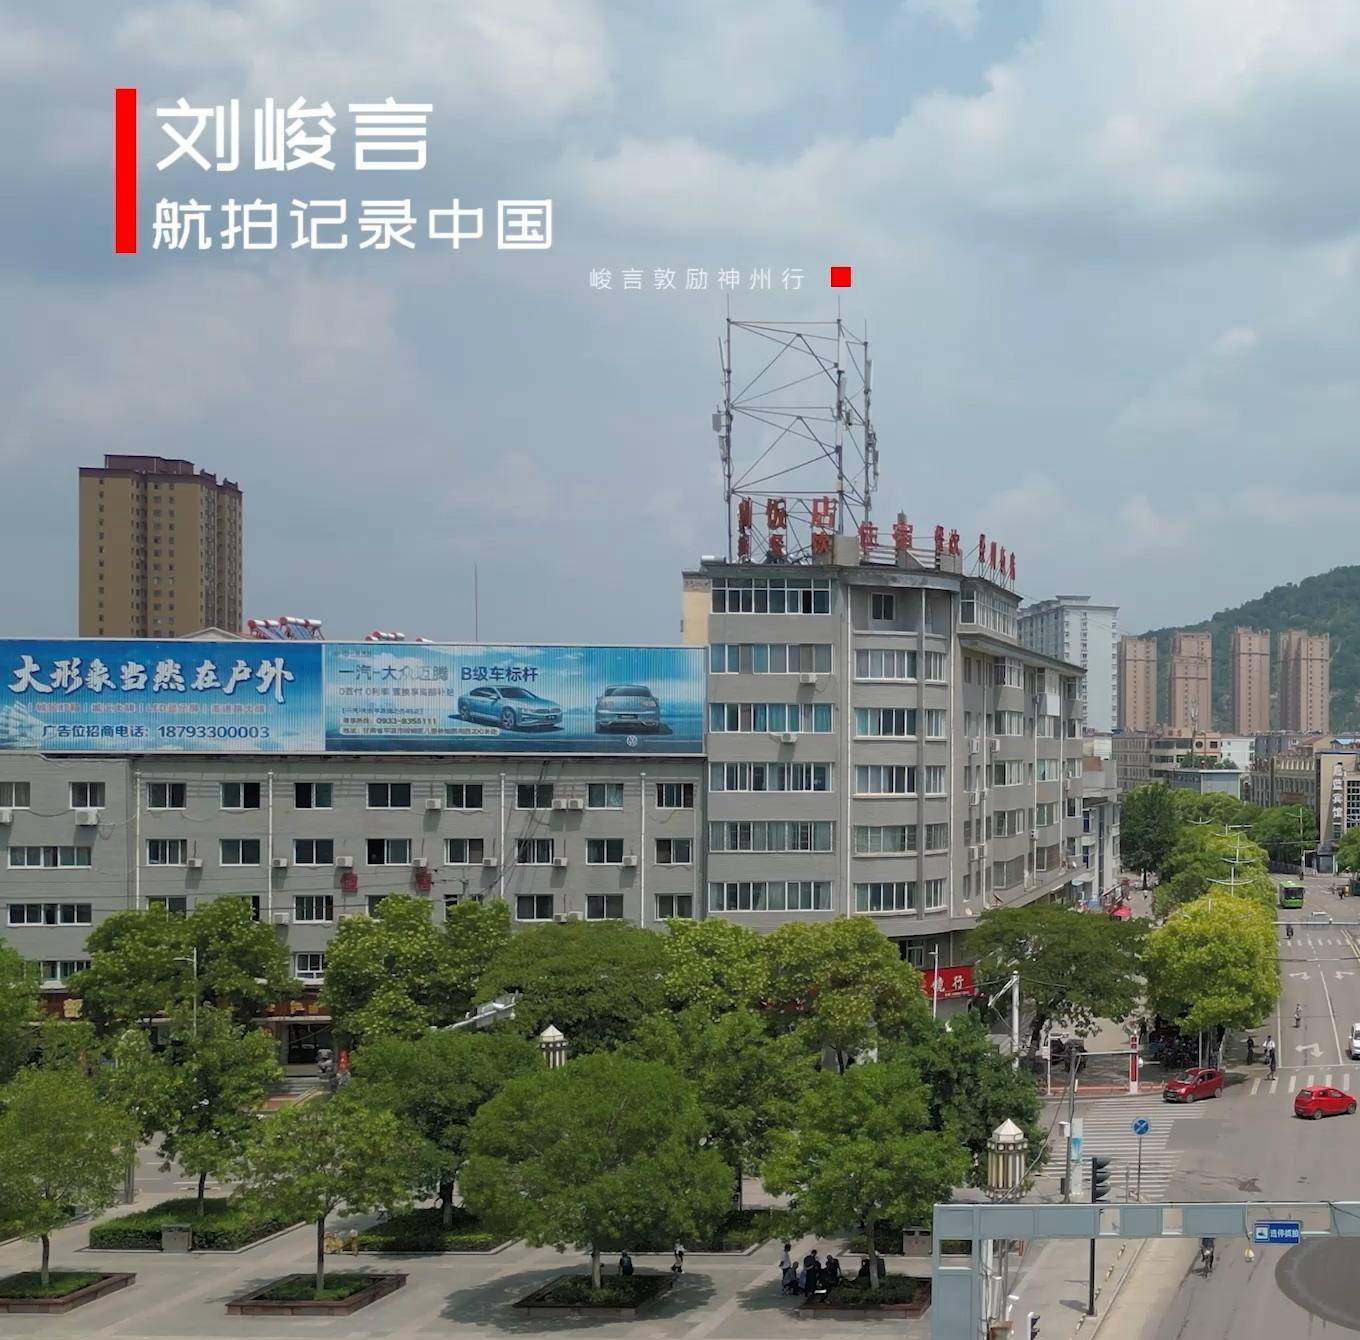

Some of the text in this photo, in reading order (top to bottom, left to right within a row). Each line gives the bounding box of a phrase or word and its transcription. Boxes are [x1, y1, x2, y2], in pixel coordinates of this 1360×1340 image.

[7, 655, 296, 703] 大形象当然在户外
[460, 665, 539, 682] B级车标杆
[157, 725, 271, 739] 18793300003
